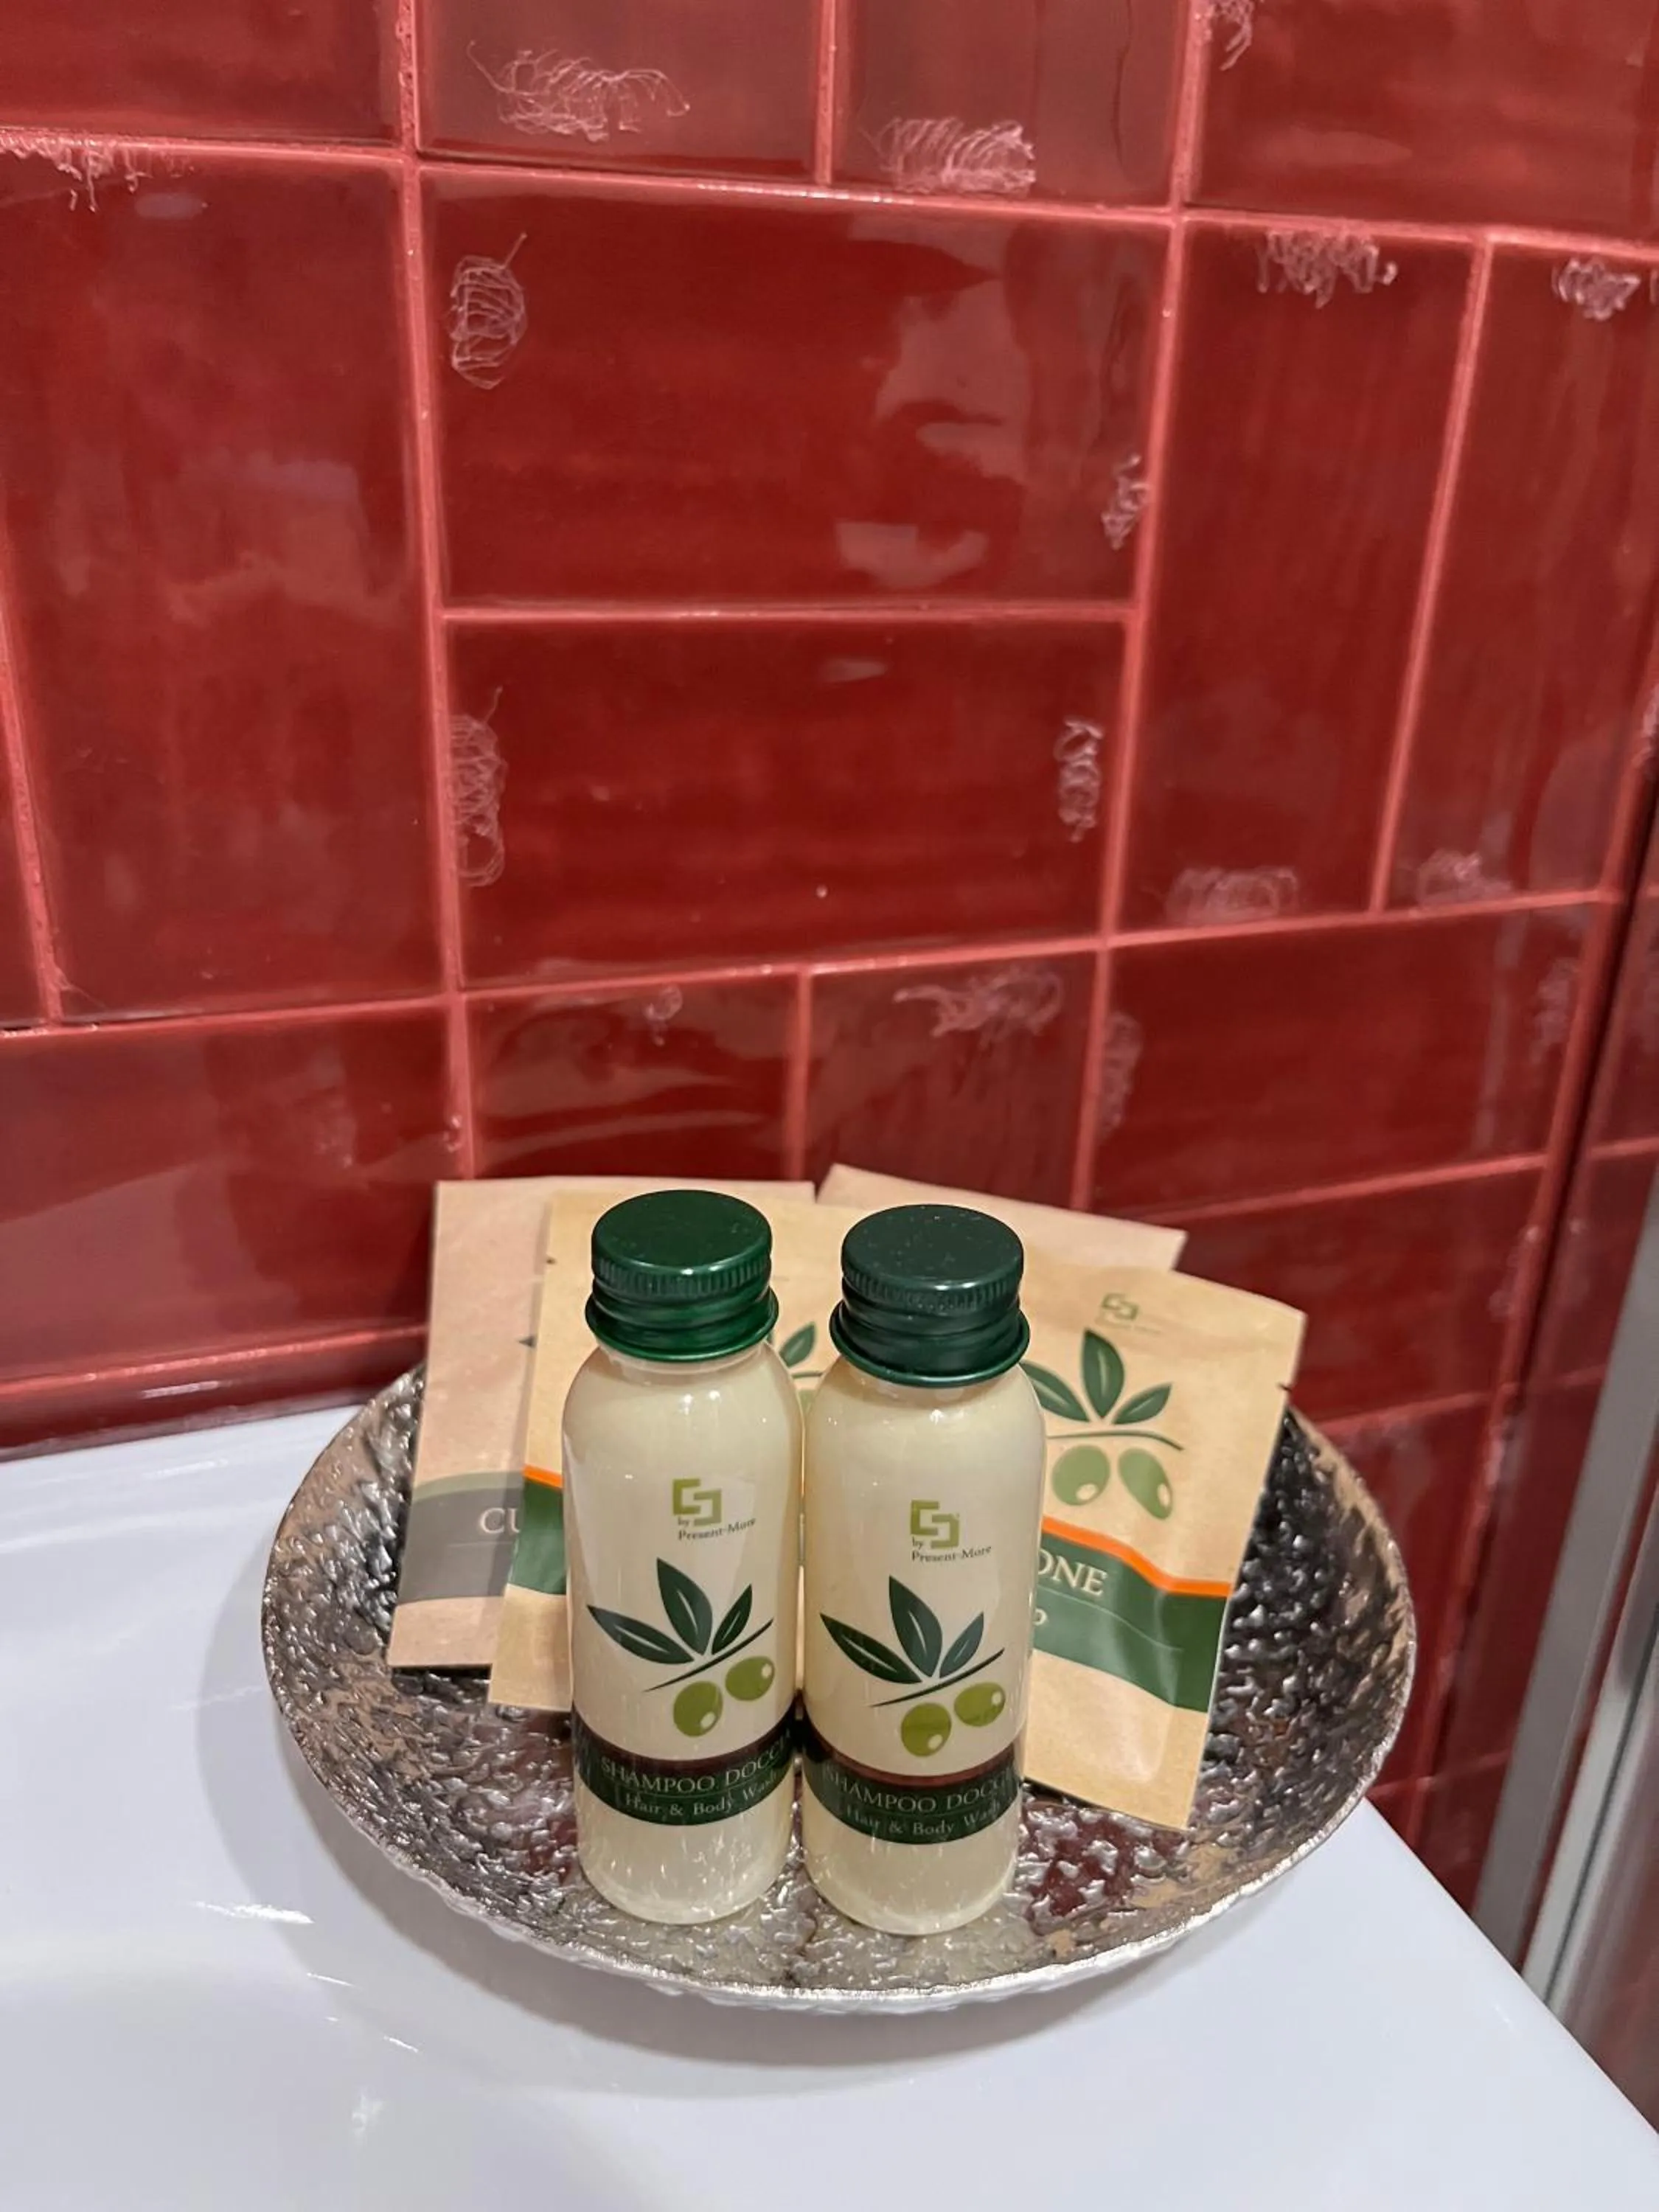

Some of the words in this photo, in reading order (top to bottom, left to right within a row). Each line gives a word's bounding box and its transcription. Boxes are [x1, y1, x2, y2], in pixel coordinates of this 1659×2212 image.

[678, 1517, 689, 1528] by
[912, 1536, 924, 1550] by
[600, 1756, 715, 1794] SHAMPOO
[825, 1764, 936, 1813] SHAMPOO
[625, 1790, 660, 1815] Hair
[669, 1804, 684, 1816] &
[693, 1795, 732, 1815] Body
[846, 1804, 880, 1829] Hair
[888, 1822, 903, 1834] &
[912, 1820, 954, 1836] Body
